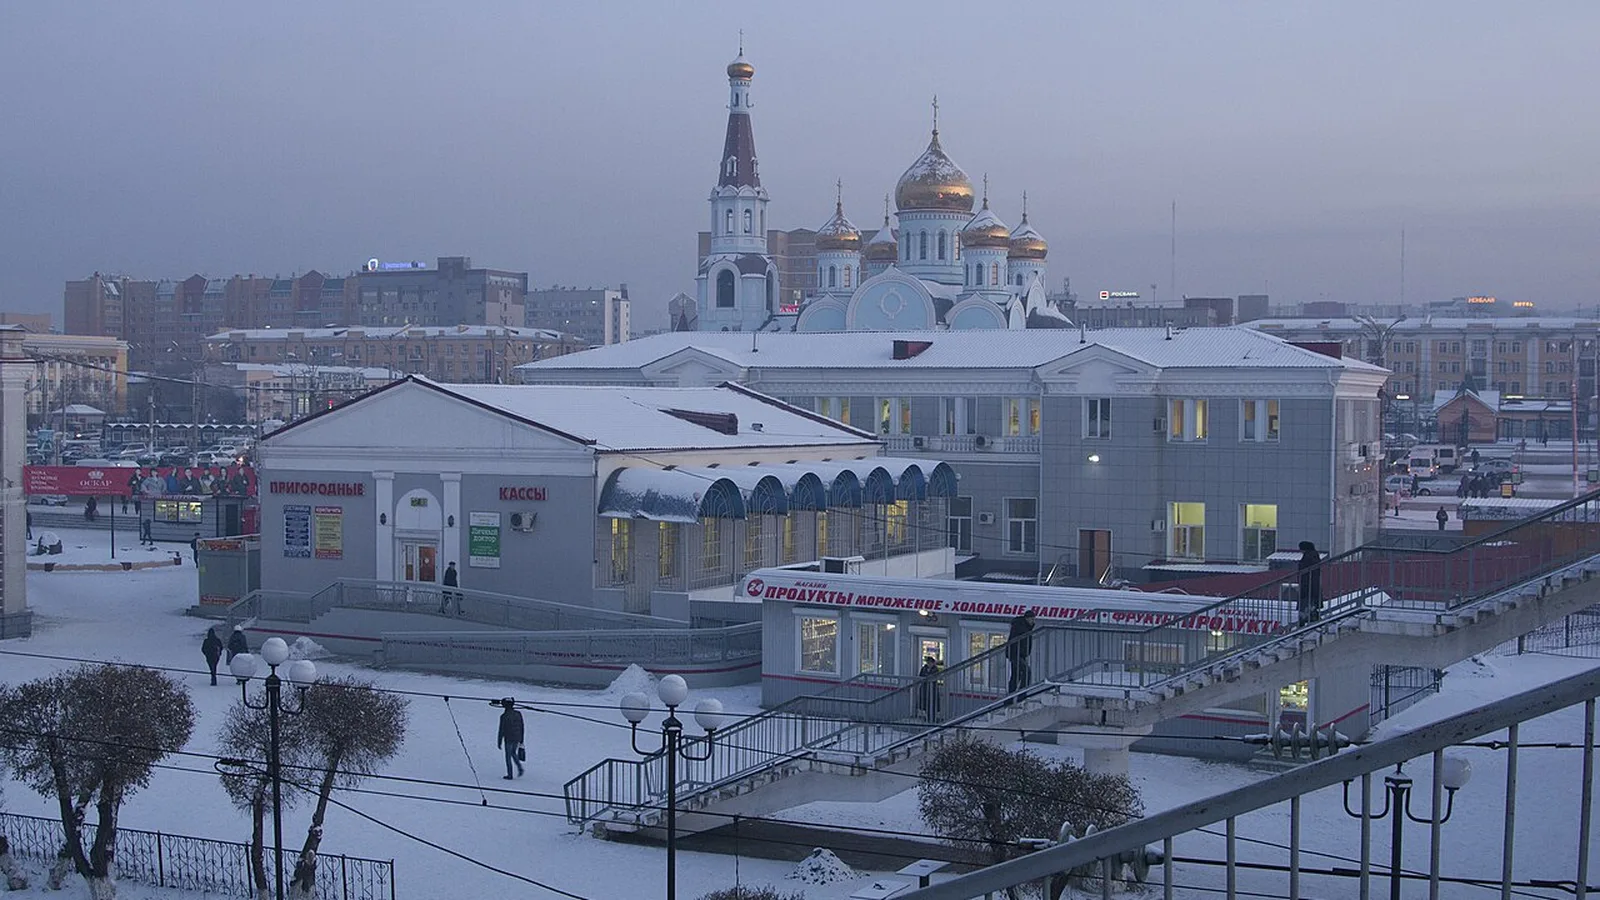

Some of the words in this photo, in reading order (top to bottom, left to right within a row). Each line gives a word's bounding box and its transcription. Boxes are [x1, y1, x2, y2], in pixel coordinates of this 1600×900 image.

[79, 479, 113, 487] ОСКАР
[269, 481, 365, 497] ПРИГОРОДНЫЕ
[499, 486, 548, 501] КАССЫ
[794, 580, 828, 588] МАГАЗИН
[764, 586, 854, 605] ПРОДУКТЫ
[855, 595, 943, 610] МОРОЖЕНОЕ
[951, 601, 1027, 616] ХОЛОДНЫЕ
[1030, 605, 1097, 620] НАПИТКИ
